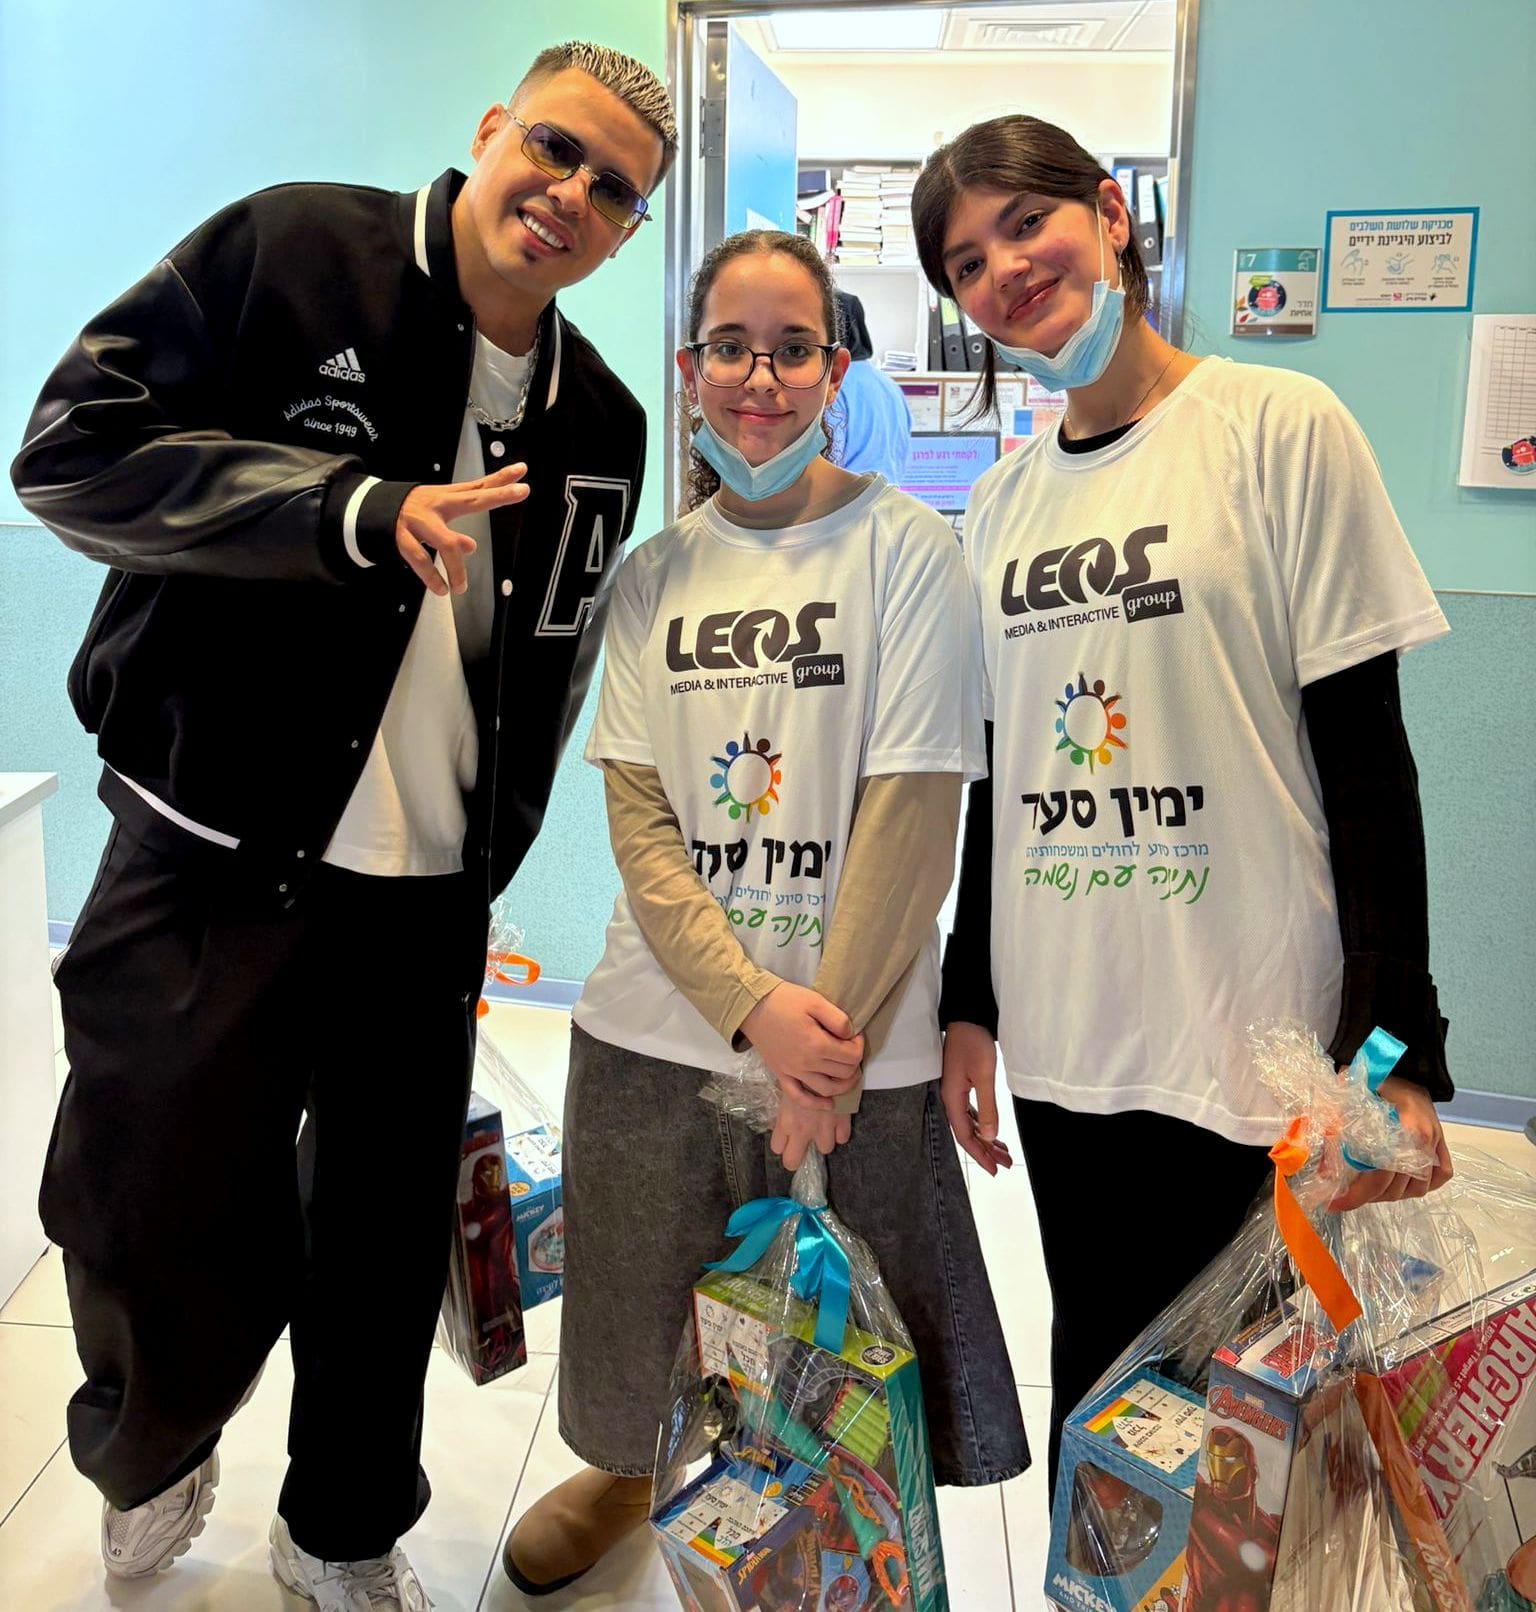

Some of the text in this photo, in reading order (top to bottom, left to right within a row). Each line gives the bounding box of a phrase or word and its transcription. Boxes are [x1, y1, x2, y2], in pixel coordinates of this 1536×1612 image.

[1349, 219, 1453, 231] טכניקת שלושת השלבים
[1349, 232, 1452, 247] לביצוע היגיינת ידיים
[318, 364, 366, 383] adidas
[283, 395, 379, 442] Adidas Sportswear
[303, 417, 358, 438] since 1949
[534, 475, 631, 636] A
[1001, 524, 1168, 616] LEOS
[666, 601, 836, 672] LEOS
[1004, 590, 1177, 640] MEDIA & INTERACTIVE group
[670, 663, 841, 695] MEDIA & INTERACTIVE group
[1021, 785, 1204, 838] ימין סעד
[761, 838, 832, 885] ימין
[1092, 840, 1141, 857] לחולים
[1172, 843, 1209, 857] מרכז
[1024, 862, 1210, 905] נתינה עם נשמה
[1208, 1384, 1292, 1441] AVENGERS
[1418, 1300, 1536, 1517] ARCHERY
